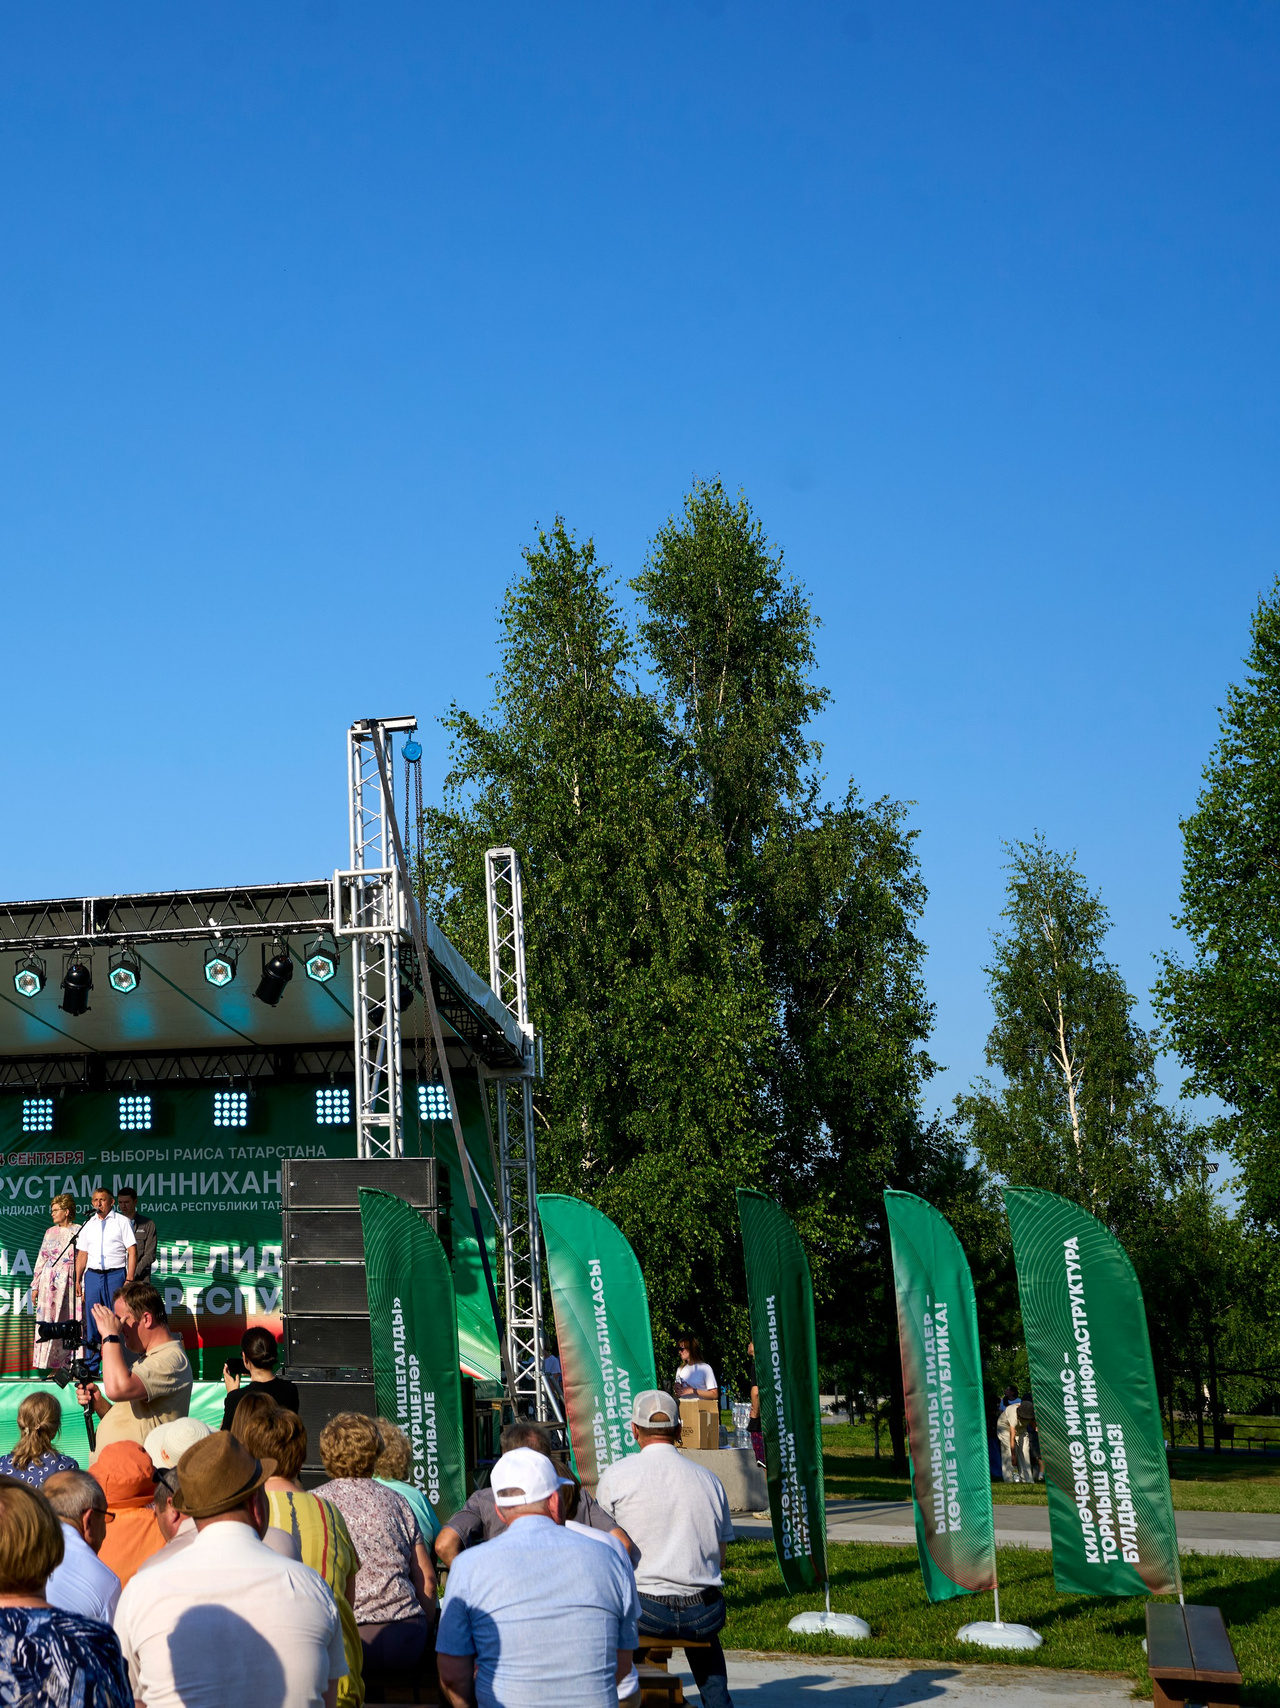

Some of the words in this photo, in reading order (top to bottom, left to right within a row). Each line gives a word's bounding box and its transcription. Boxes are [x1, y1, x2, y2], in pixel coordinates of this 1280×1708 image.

[8, 1150, 85, 1166] СЕНТЯБРЯ
[100, 1148, 169, 1163] ВЫБОРЫ
[173, 1147, 225, 1161] РАИСА
[228, 1144, 328, 1160] ТАТАРСТАНА
[140, 1202, 178, 1214] РАИСА
[180, 1200, 258, 1213] РЕСПУБЛИКИ
[588, 1259, 618, 1420] РЕСПУБЛИКАСЫ
[923, 1312, 937, 1386] ЛИДЕР
[1063, 1236, 1099, 1407] ИНФРАСТРУКТУРА
[408, 1354, 425, 1461] КҮРШЕЛӘР
[616, 1366, 636, 1447] САЙЛАУ
[934, 1302, 956, 1453] РЕСПУБЛИКА!
[1059, 1368, 1083, 1437] МИРАС
[423, 1391, 440, 1505] ФЕСТИВАЛЕ
[927, 1392, 947, 1535] ЫШАНЫЧЛЫ
[1084, 1412, 1107, 1466] ӨЧЕН
[800, 1484, 813, 1556] ШТАБЫ
[945, 1458, 962, 1532] КӨЧЛЕ
[1069, 1440, 1101, 1564] КИЛӘЧӘККӘ
[1092, 1470, 1119, 1564] ТОРМЫШ
[1105, 1423, 1140, 1564] БУЛДЫРАБЫЗ!
